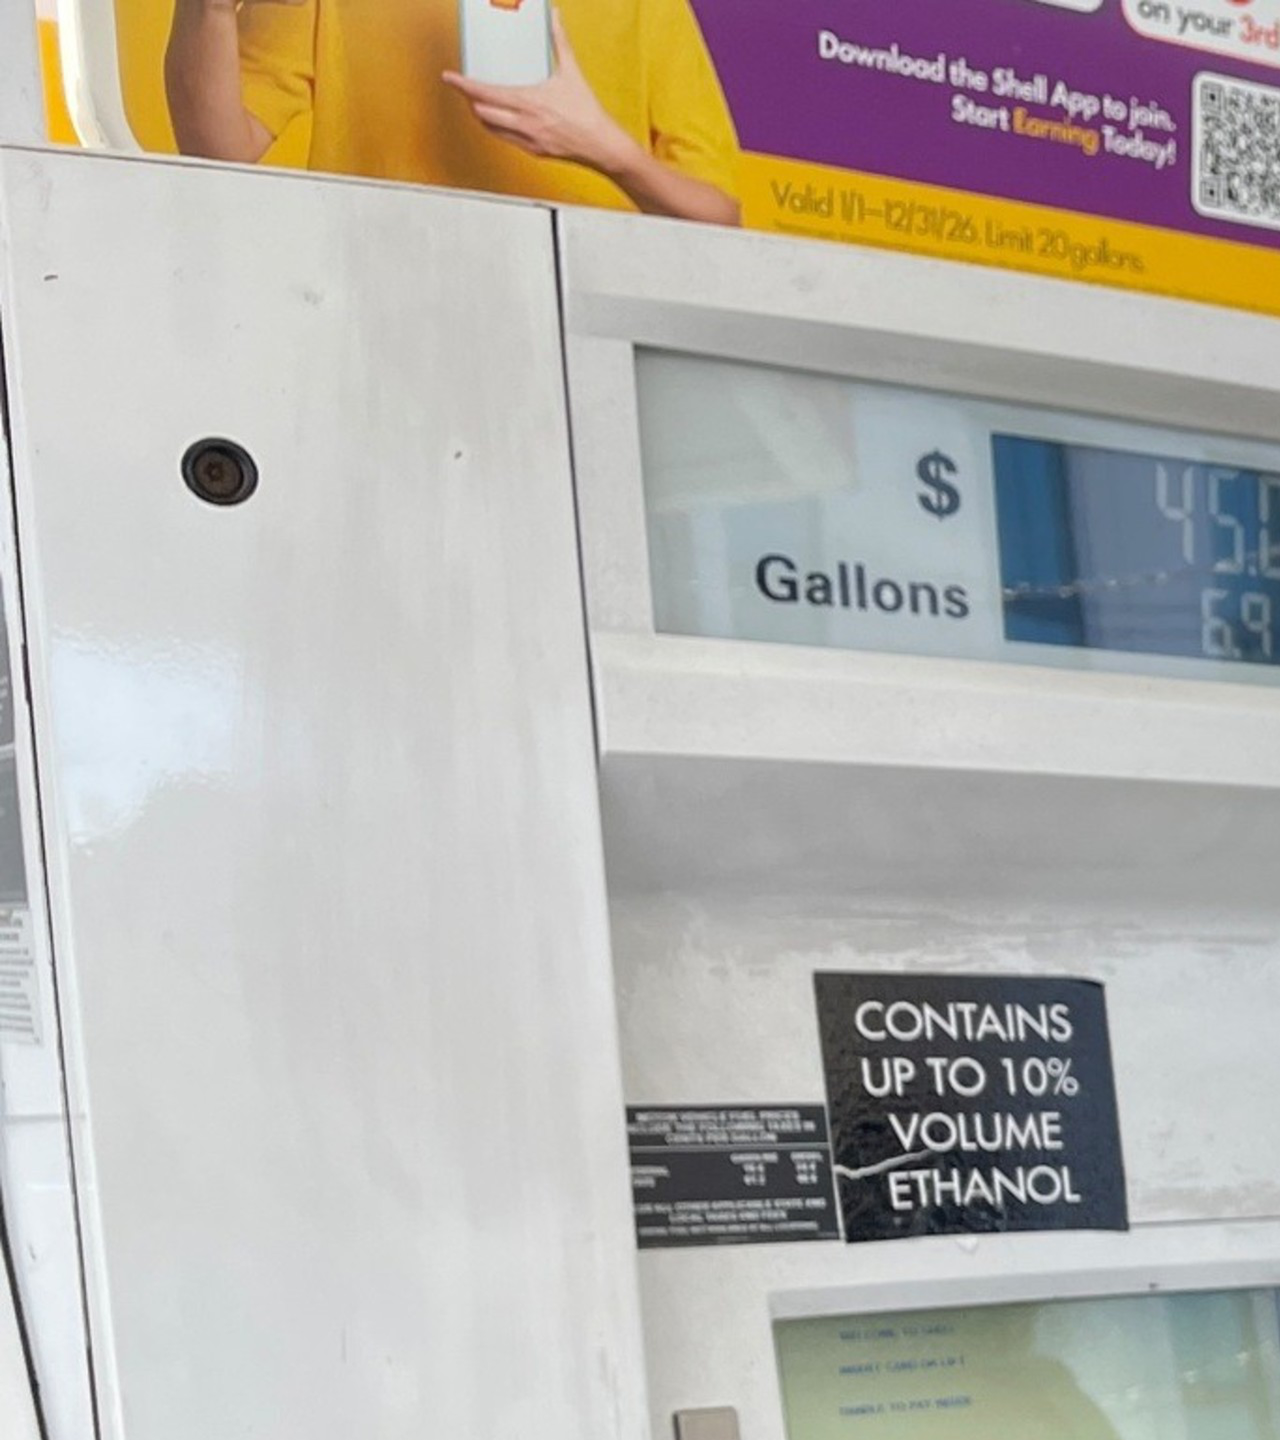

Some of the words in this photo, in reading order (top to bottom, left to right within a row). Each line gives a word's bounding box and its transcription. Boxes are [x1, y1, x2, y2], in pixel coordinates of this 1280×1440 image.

[1176, 8, 1233, 36] your
[1240, 20, 1280, 49] 3rd
[818, 30, 945, 83] Download
[950, 60, 987, 92] the
[993, 68, 1047, 106] Shell
[1051, 82, 1098, 120] App
[1103, 96, 1127, 120] to
[1129, 99, 1176, 132] join.
[952, 95, 1009, 132] Start
[1013, 108, 1098, 156] Earning
[1102, 126, 1177, 170] Today!
[770, 180, 834, 218] Valid
[986, 220, 1034, 253] Limit
[1038, 227, 1068, 260] 20
[916, 448, 961, 521] $
[755, 553, 970, 621] Gallons
[855, 1001, 1073, 1043] CONTAINS
[860, 1058, 916, 1097] UP
[927, 1057, 985, 1097] TO
[1003, 1057, 1079, 1097] 10%
[888, 1110, 1064, 1151] VOLUME
[888, 1165, 1081, 1211] ETHANOL
